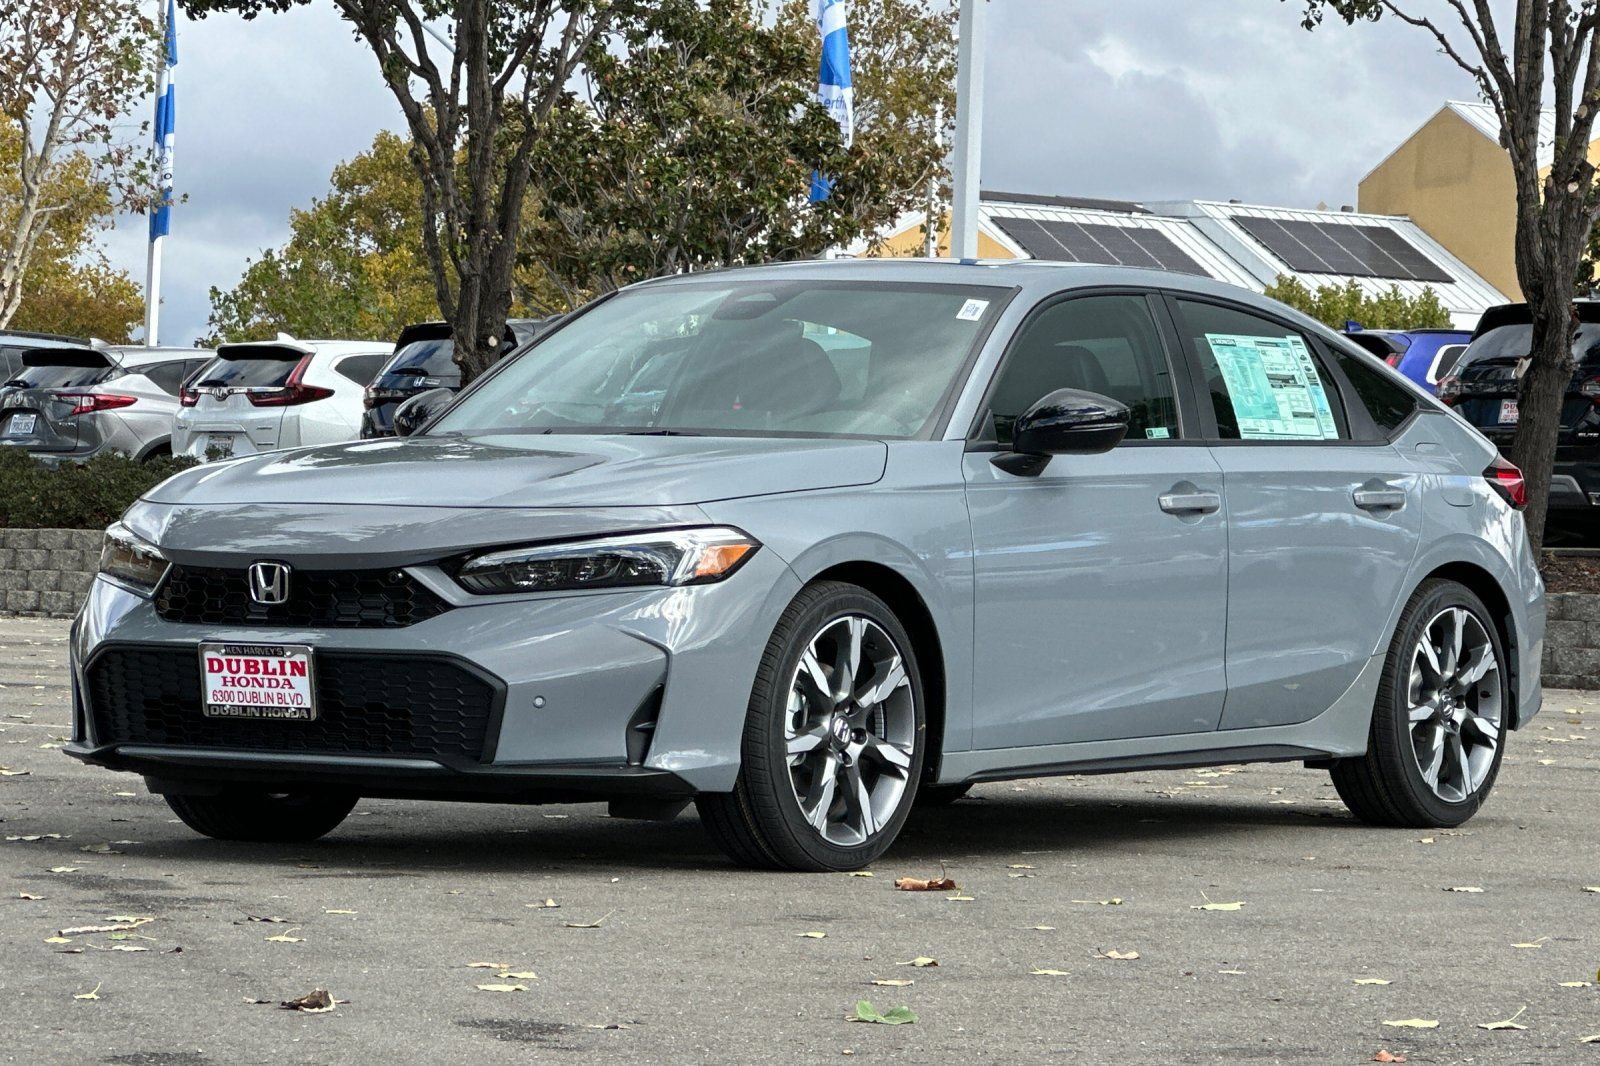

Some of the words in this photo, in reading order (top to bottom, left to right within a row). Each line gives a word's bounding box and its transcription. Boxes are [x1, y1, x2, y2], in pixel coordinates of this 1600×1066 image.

[225, 646, 242, 655] KEN
[243, 646, 283, 656] HARVEY'S
[207, 658, 307, 677] DUBLIN
[221, 676, 295, 689] HONDA
[212, 690, 236, 703] 6300
[237, 691, 275, 705] DUBLIN
[276, 692, 307, 706] BLVD.
[210, 705, 260, 717] DUBLIN
[262, 707, 309, 718] HONDA
